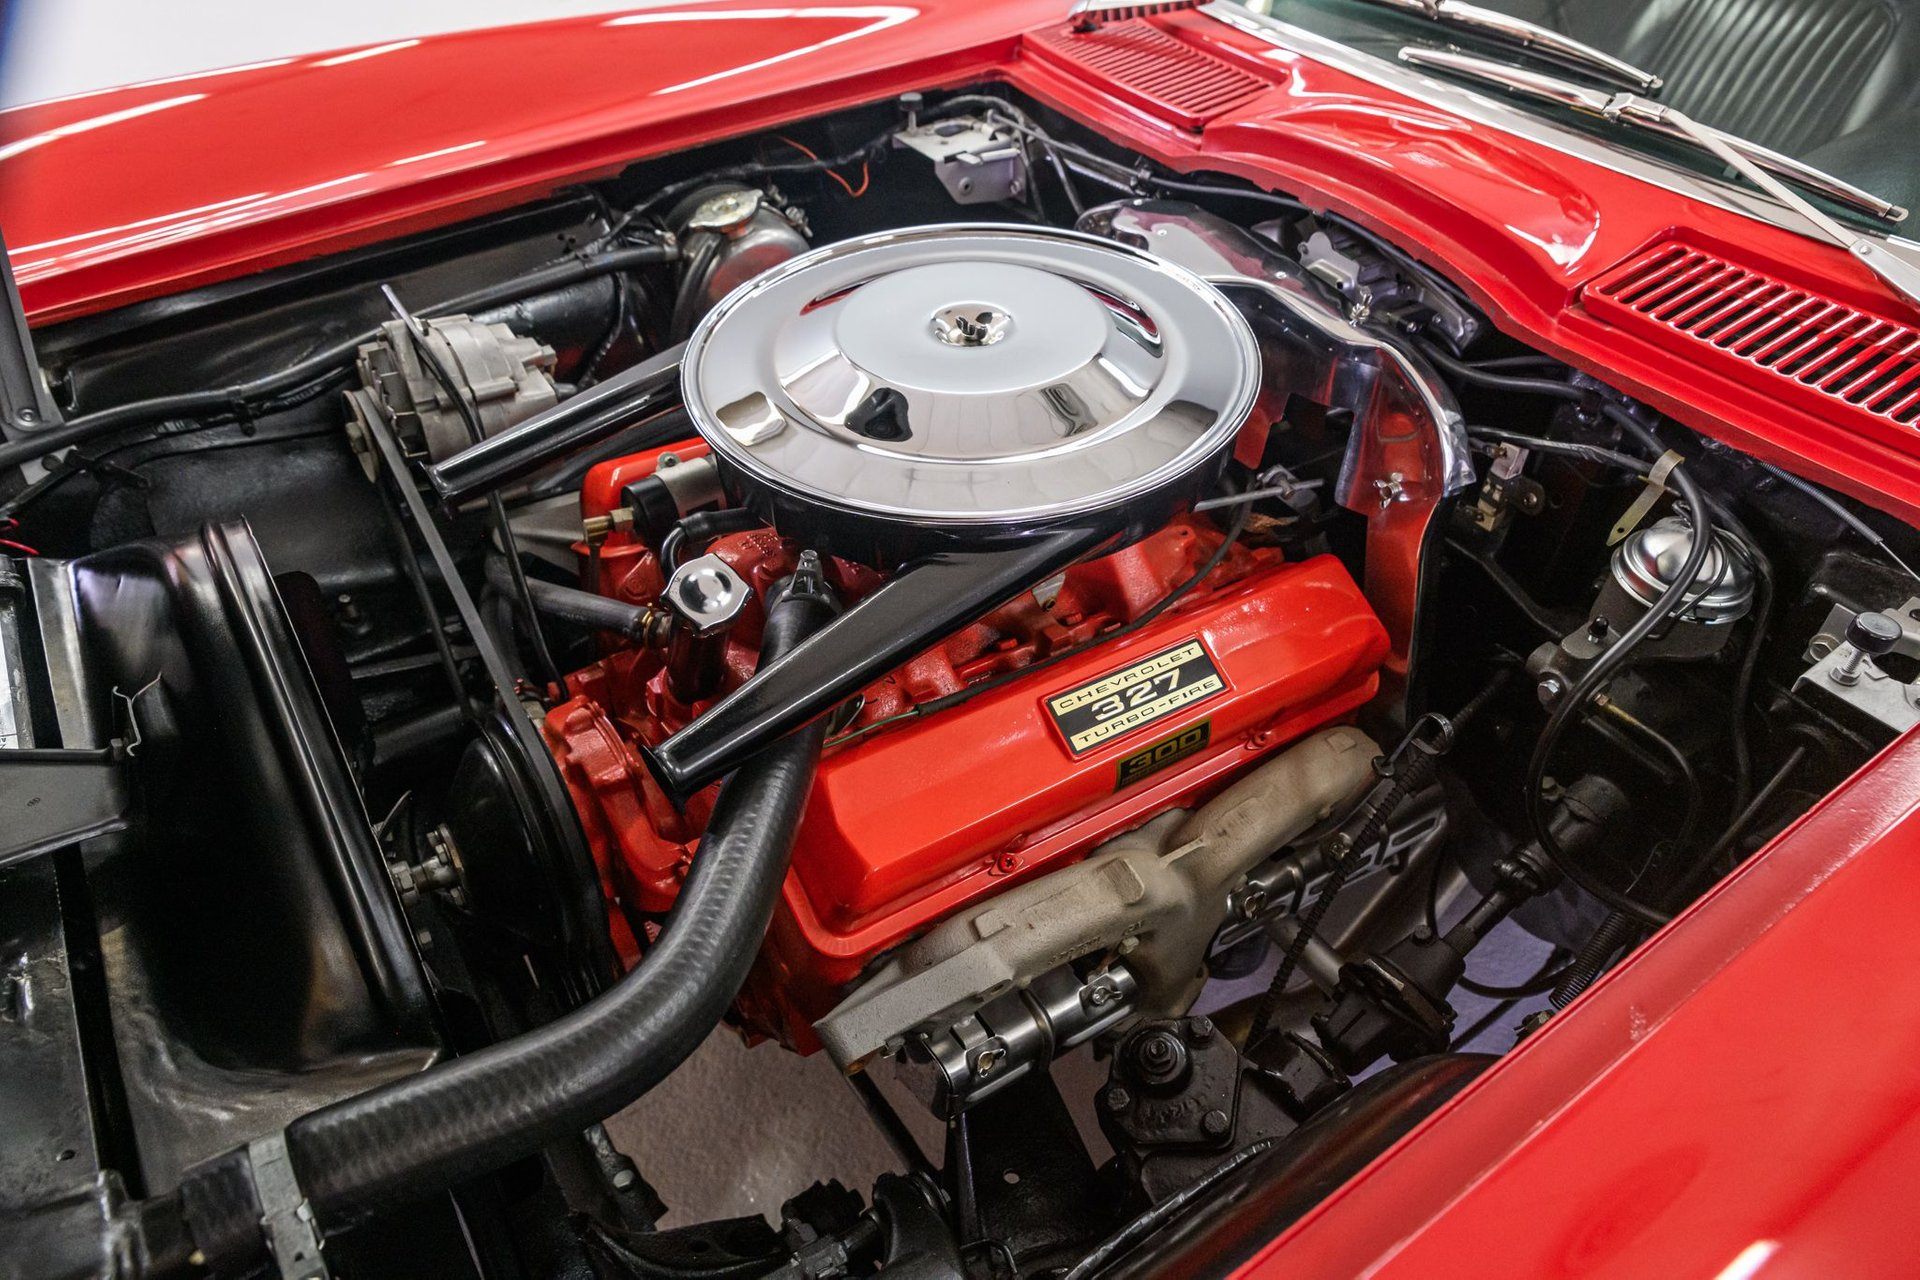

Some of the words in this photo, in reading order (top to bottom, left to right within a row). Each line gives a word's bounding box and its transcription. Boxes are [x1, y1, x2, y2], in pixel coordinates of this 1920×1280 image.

[1059, 647, 1195, 709] CHEVROLET
[1091, 667, 1181, 722] 327
[1078, 679, 1216, 743] TURBO-FIRE
[1128, 728, 1202, 774] 300
